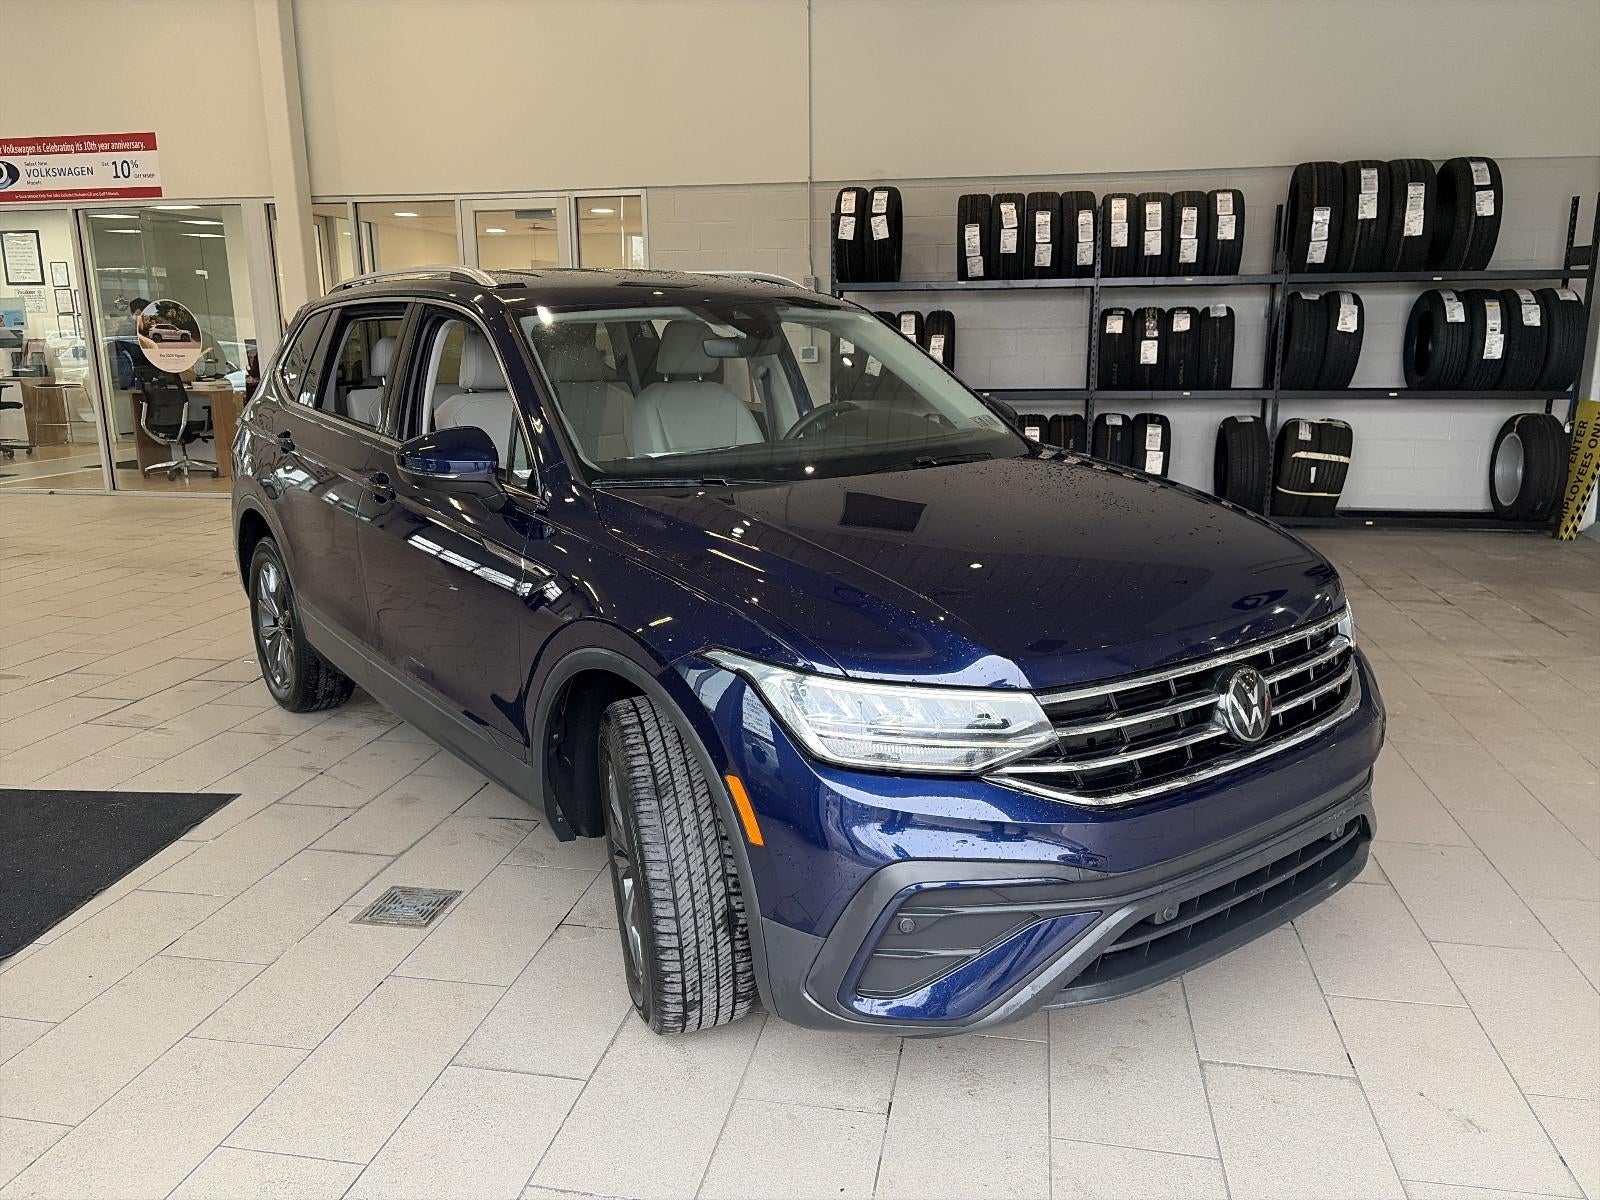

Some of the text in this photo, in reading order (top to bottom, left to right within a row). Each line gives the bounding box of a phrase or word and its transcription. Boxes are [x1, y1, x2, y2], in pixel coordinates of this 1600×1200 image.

[2, 144, 36, 155] Volkswagen
[36, 143, 42, 152] is
[42, 142, 75, 154] Celebrating
[84, 140, 97, 151] 10th
[98, 142, 110, 152] year
[25, 166, 94, 178] VOLKSWAGEN
[1569, 420, 1589, 465] ENTER
[1560, 451, 1594, 522] MPLOYEES
